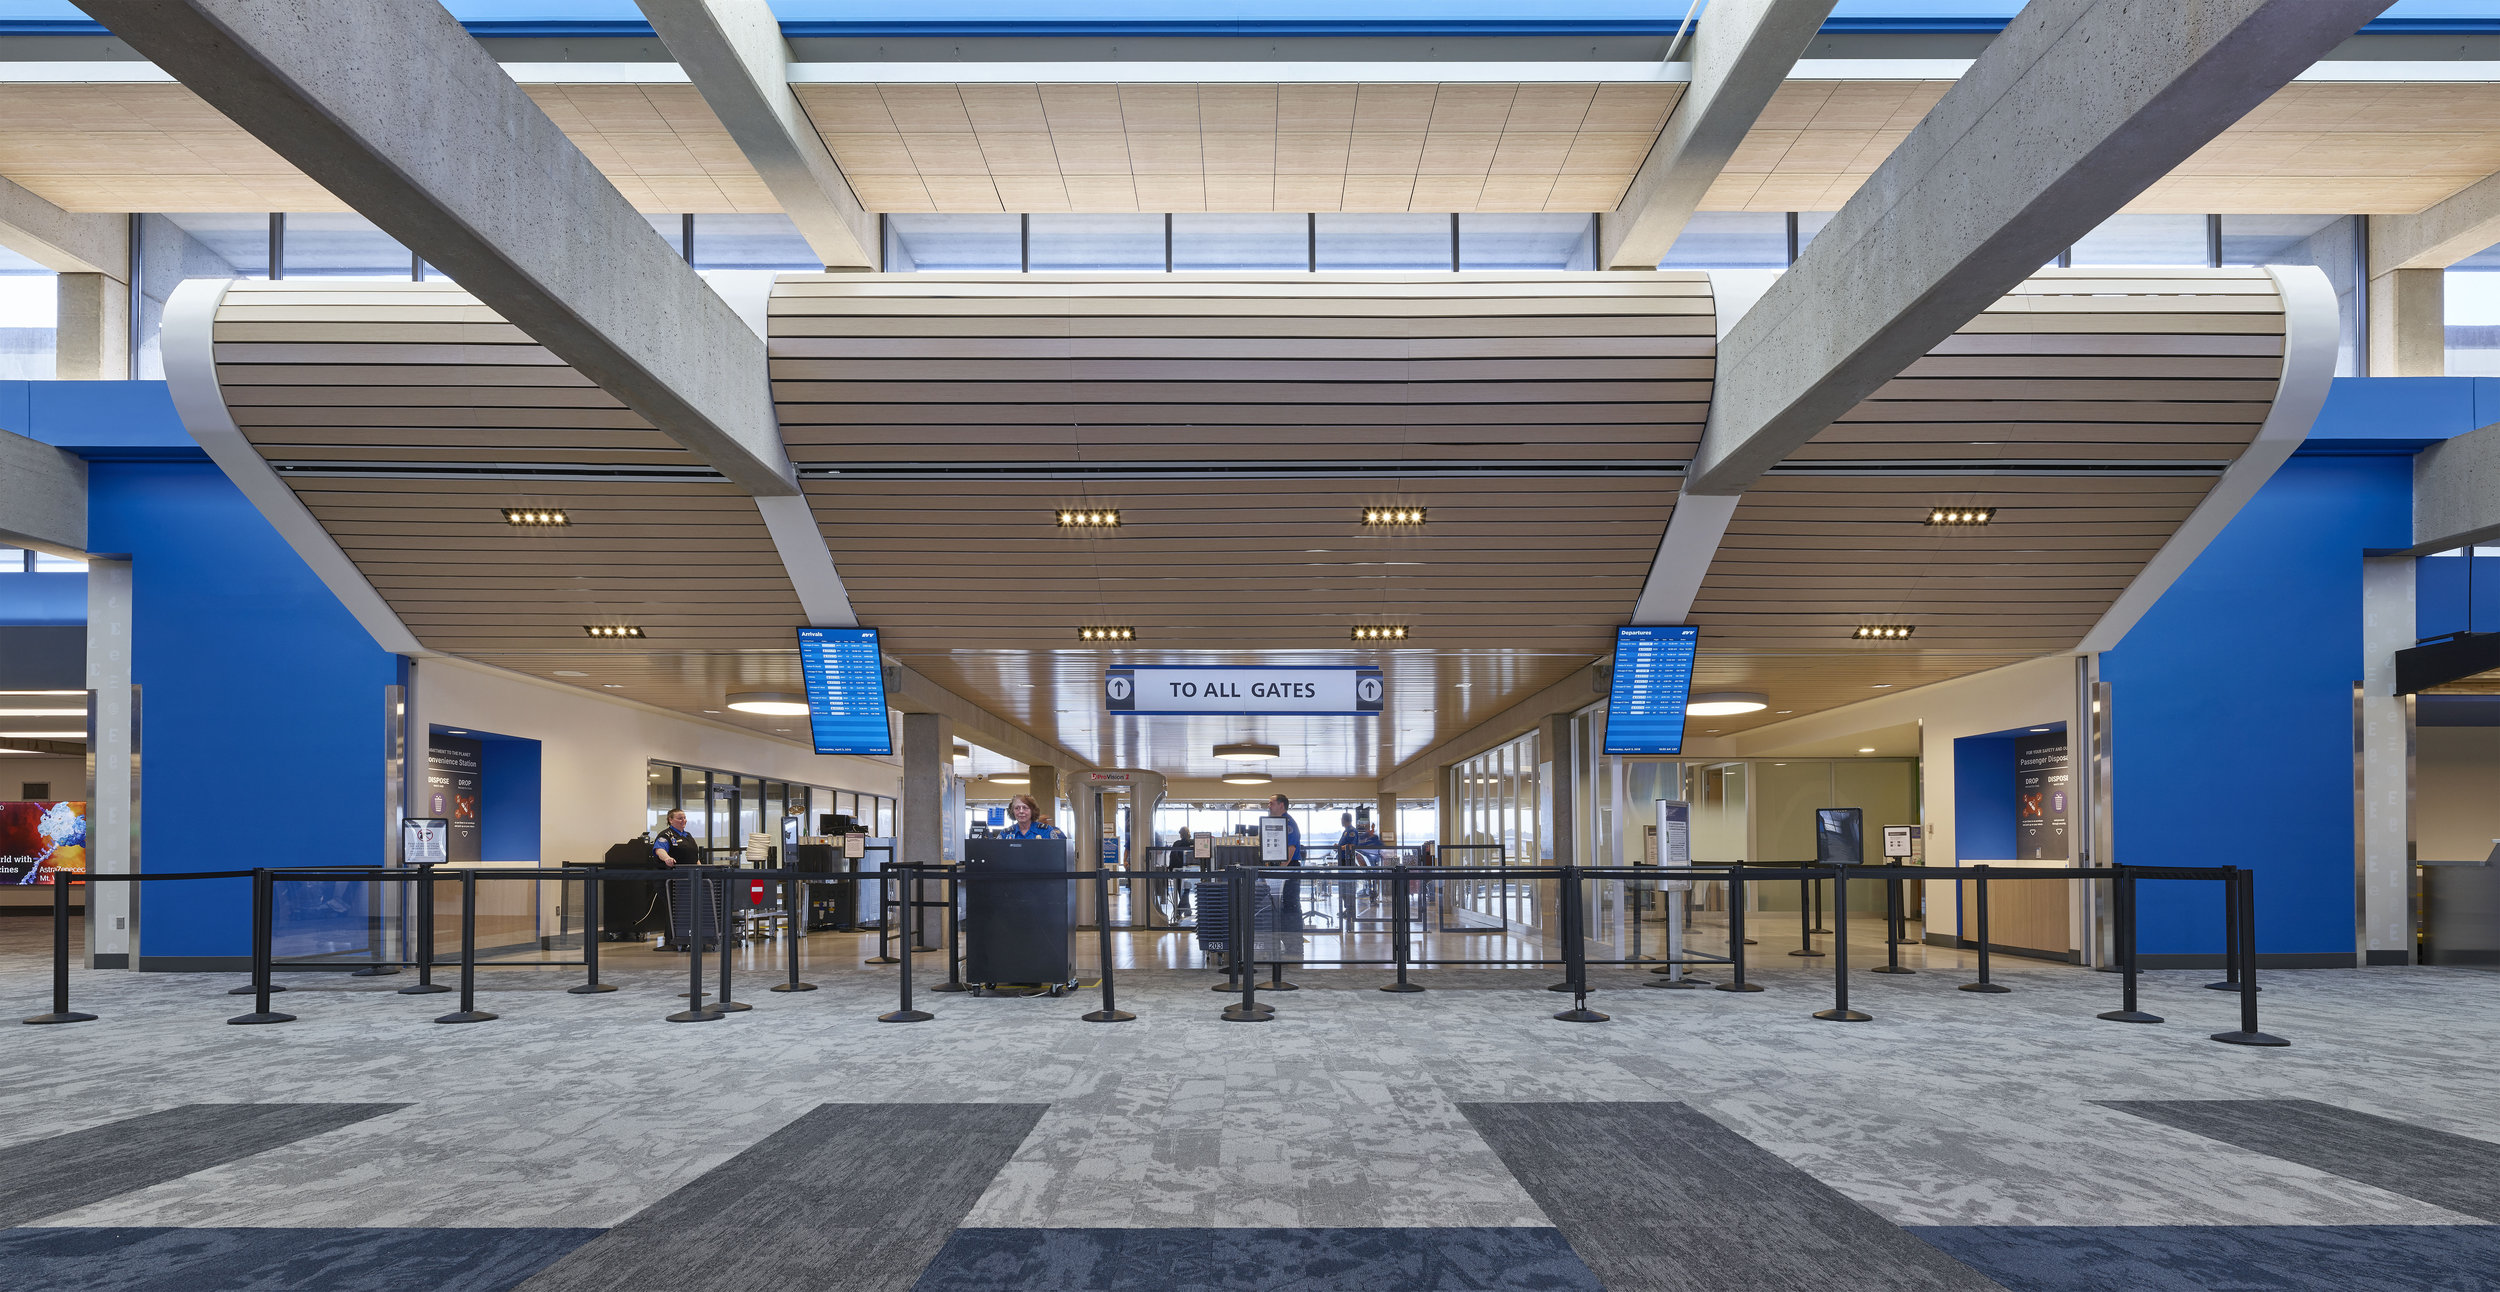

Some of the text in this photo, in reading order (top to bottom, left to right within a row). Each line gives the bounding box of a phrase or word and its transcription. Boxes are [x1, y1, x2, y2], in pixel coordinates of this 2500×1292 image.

[1170, 682, 1316, 698] TO ALL GATES
[459, 759, 477, 767] Station
[2020, 757, 2047, 766] Passenger
